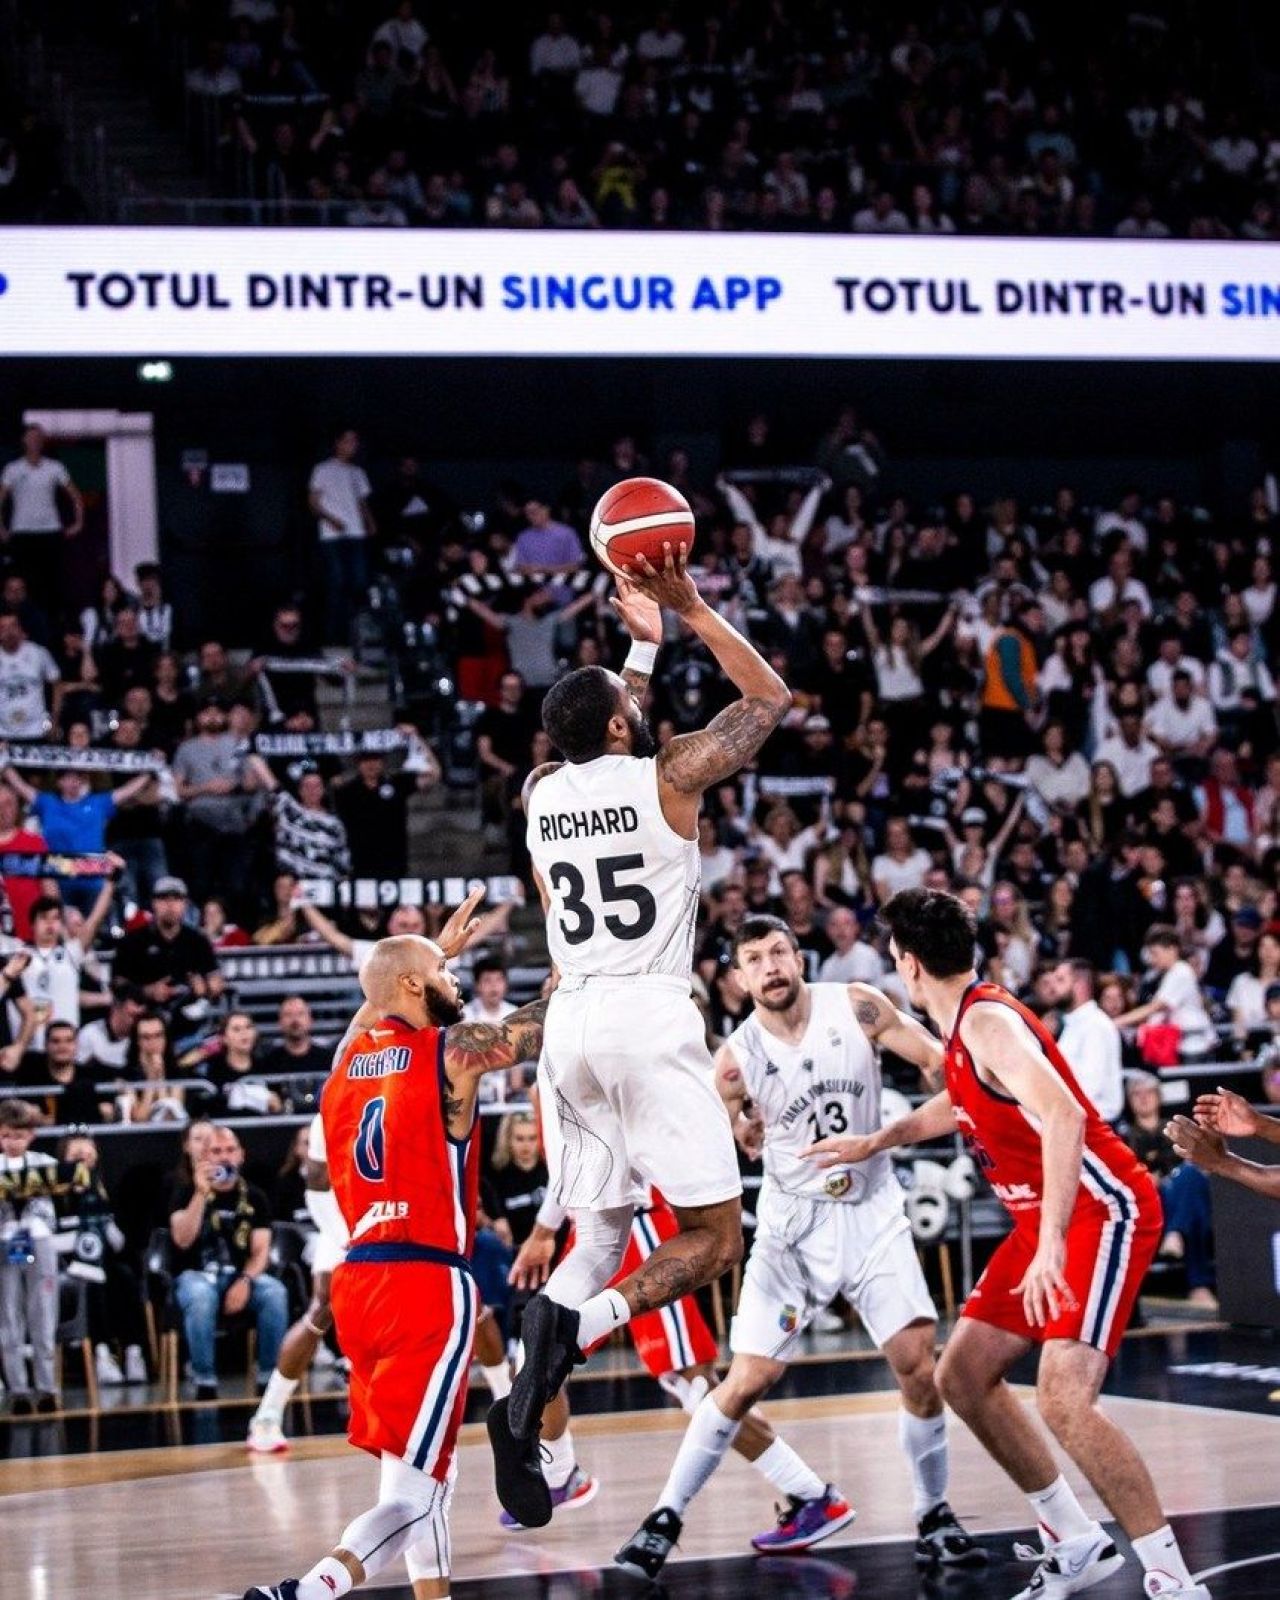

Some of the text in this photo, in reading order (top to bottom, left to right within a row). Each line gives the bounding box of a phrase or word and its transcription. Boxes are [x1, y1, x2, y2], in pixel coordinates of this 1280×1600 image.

[67, 271, 782, 311] TOTUL DINTR-UN SINGUR APP
[835, 277, 981, 314] TOTUL
[997, 280, 1206, 316] DINTR-UN
[539, 806, 638, 842] RICHARD
[549, 853, 657, 946] 35
[807, 1100, 848, 1145] 13
